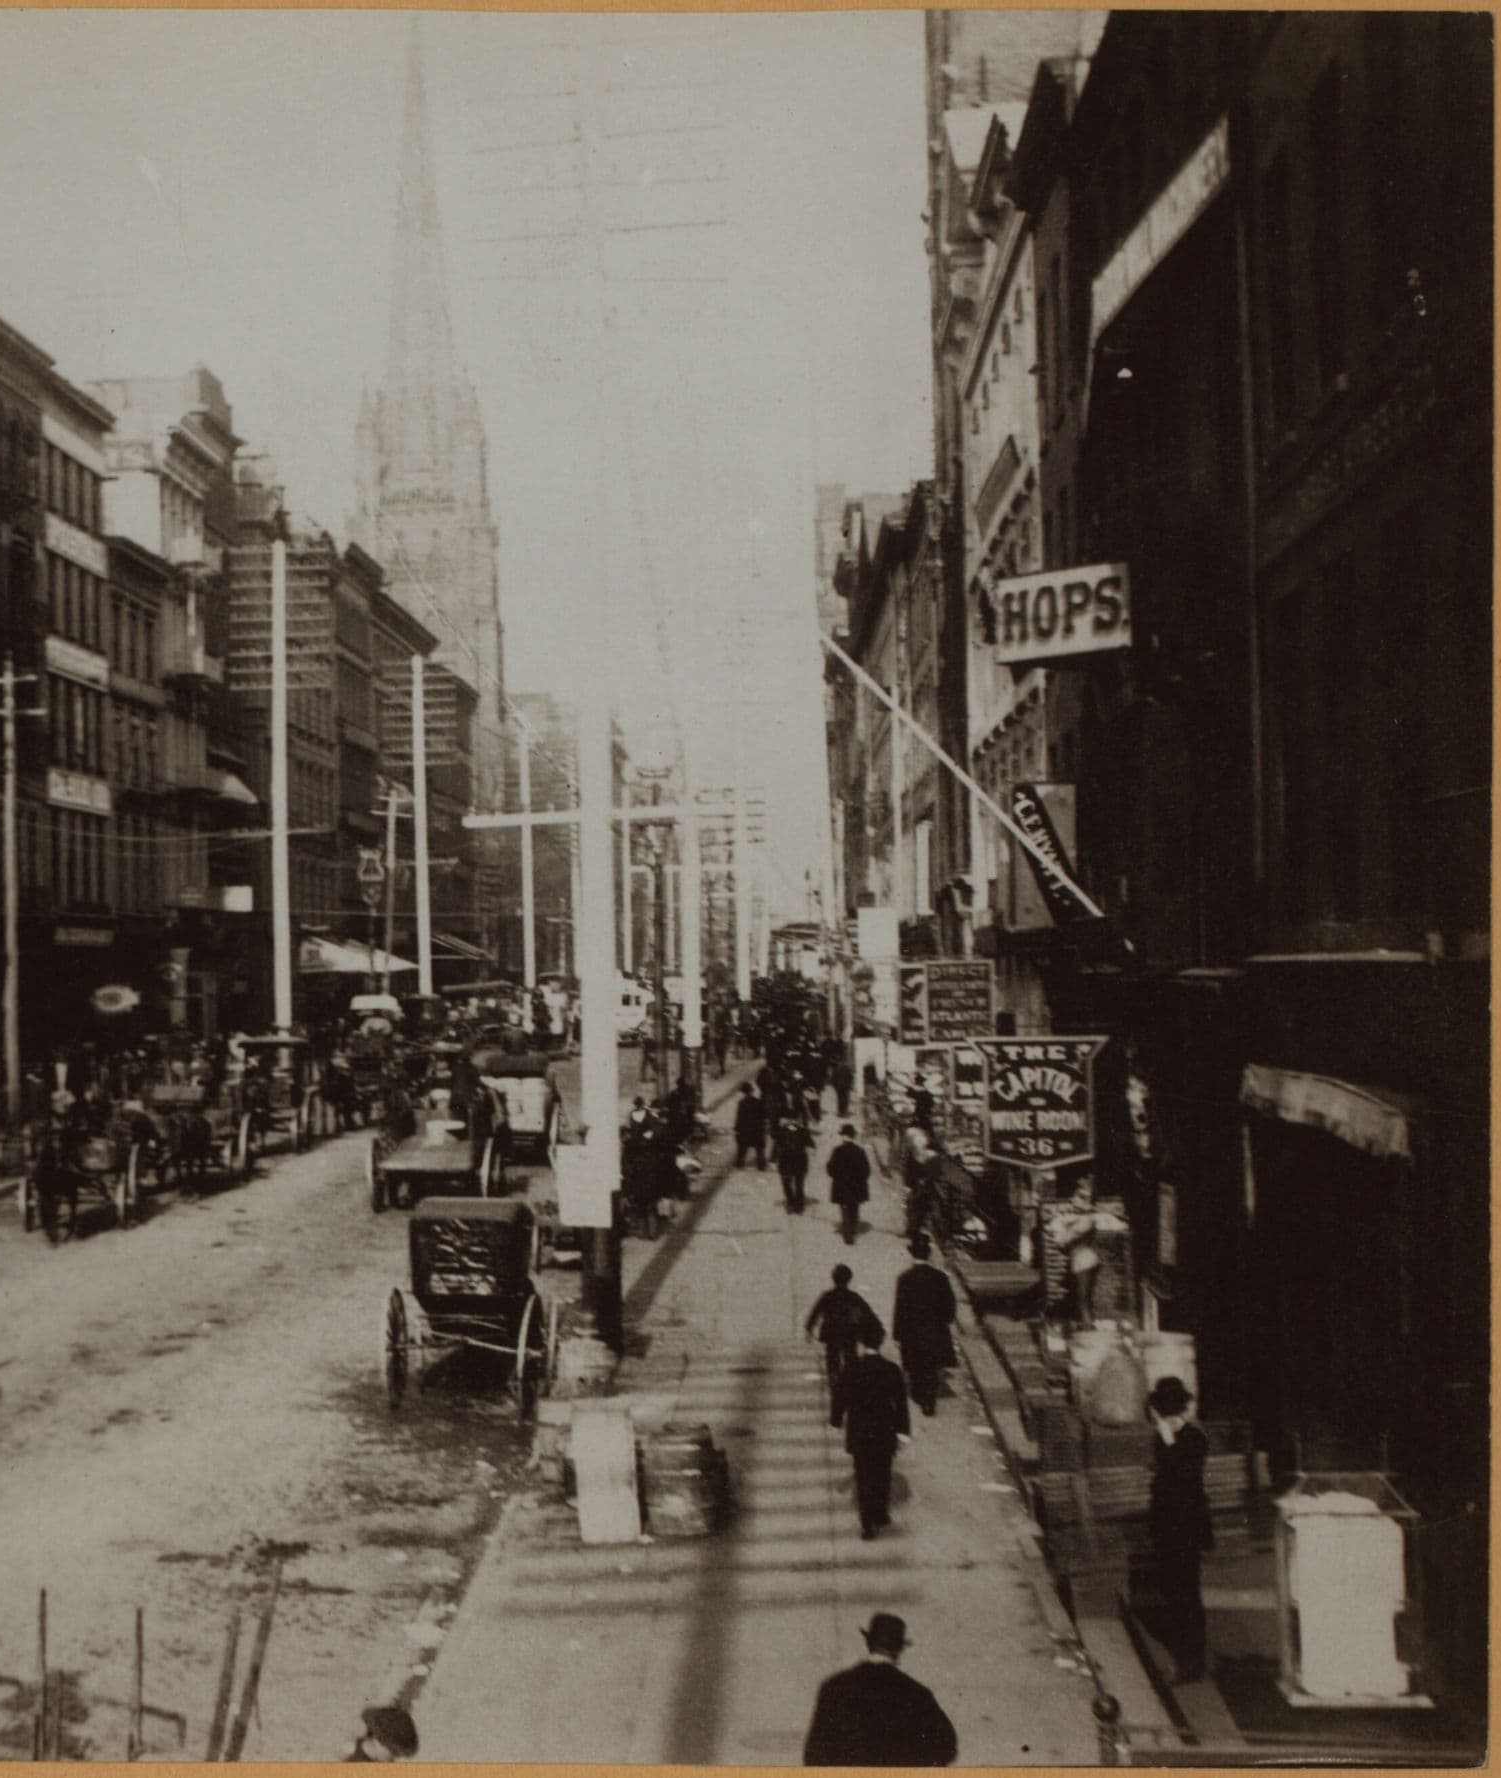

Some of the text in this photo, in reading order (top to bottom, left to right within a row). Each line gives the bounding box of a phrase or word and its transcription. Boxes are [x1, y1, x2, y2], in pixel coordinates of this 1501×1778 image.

[1002, 1045, 1067, 1060] THE
[993, 1066, 1088, 1104] CAPITOL
[990, 1111, 1034, 1131] WINE
[1036, 1111, 1086, 1131] ROOM
[1019, 1137, 1054, 1156] 36
